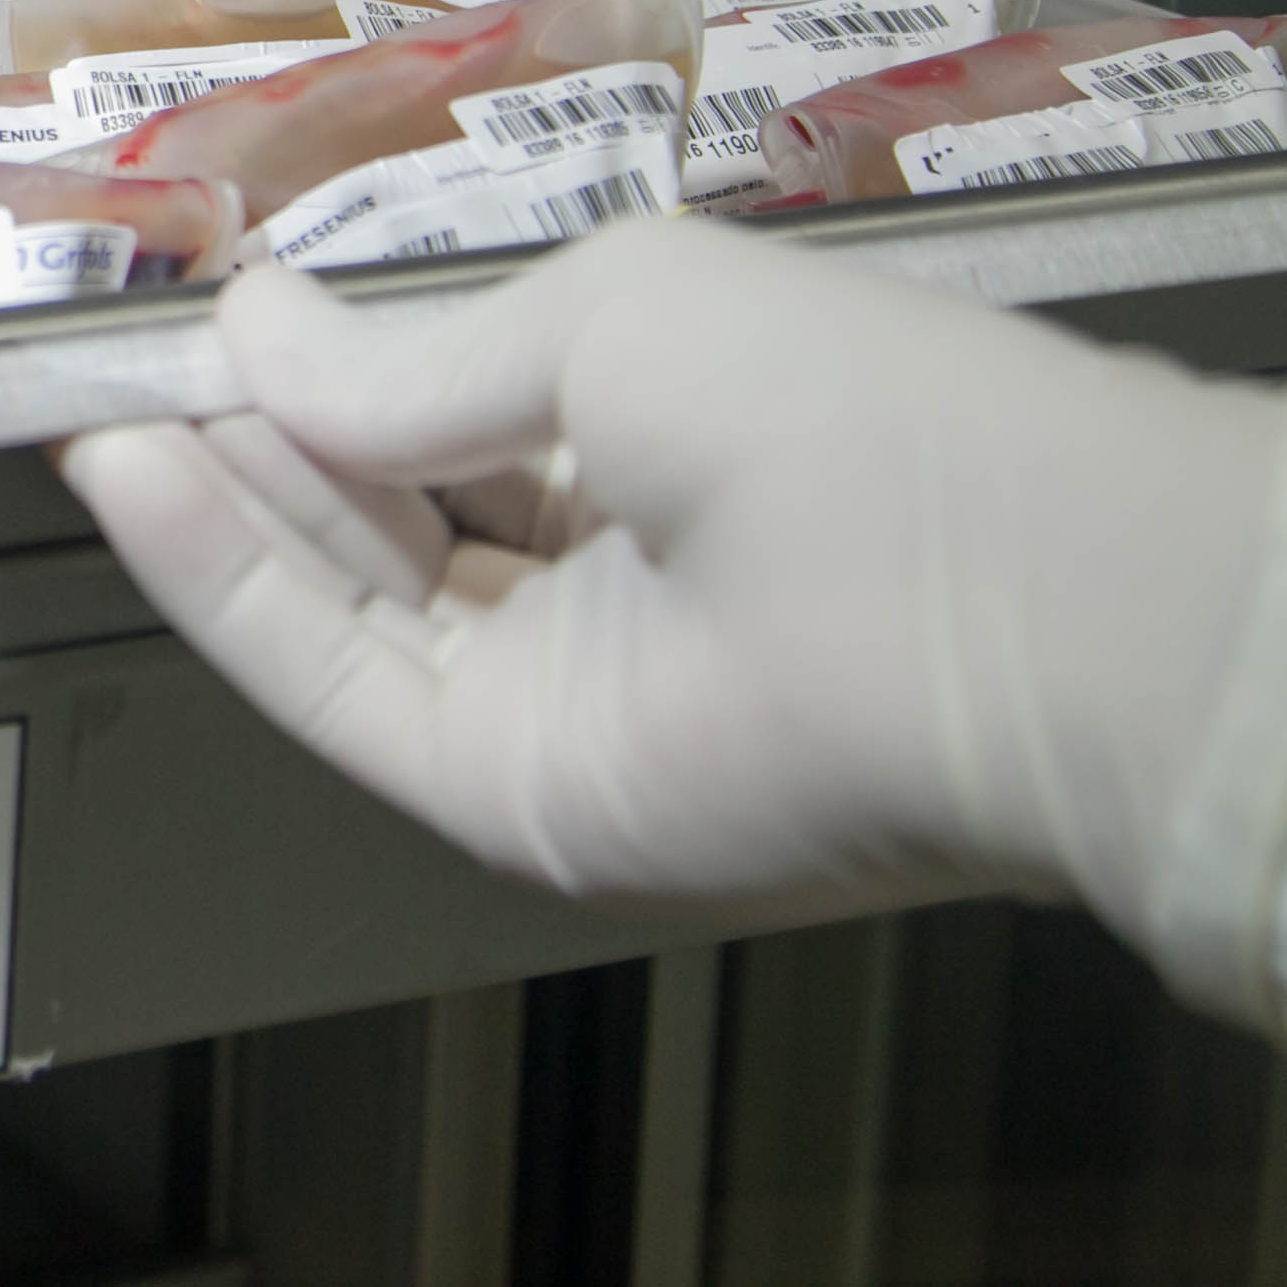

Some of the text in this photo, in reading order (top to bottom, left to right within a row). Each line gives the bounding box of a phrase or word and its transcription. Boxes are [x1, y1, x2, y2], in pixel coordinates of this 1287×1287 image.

[90, 69, 204, 85] BOLSA 1 FLN
[707, 133, 758, 158] 1190
[274, 195, 377, 265] FRESENIUS
[37, 241, 114, 271] Grifols
